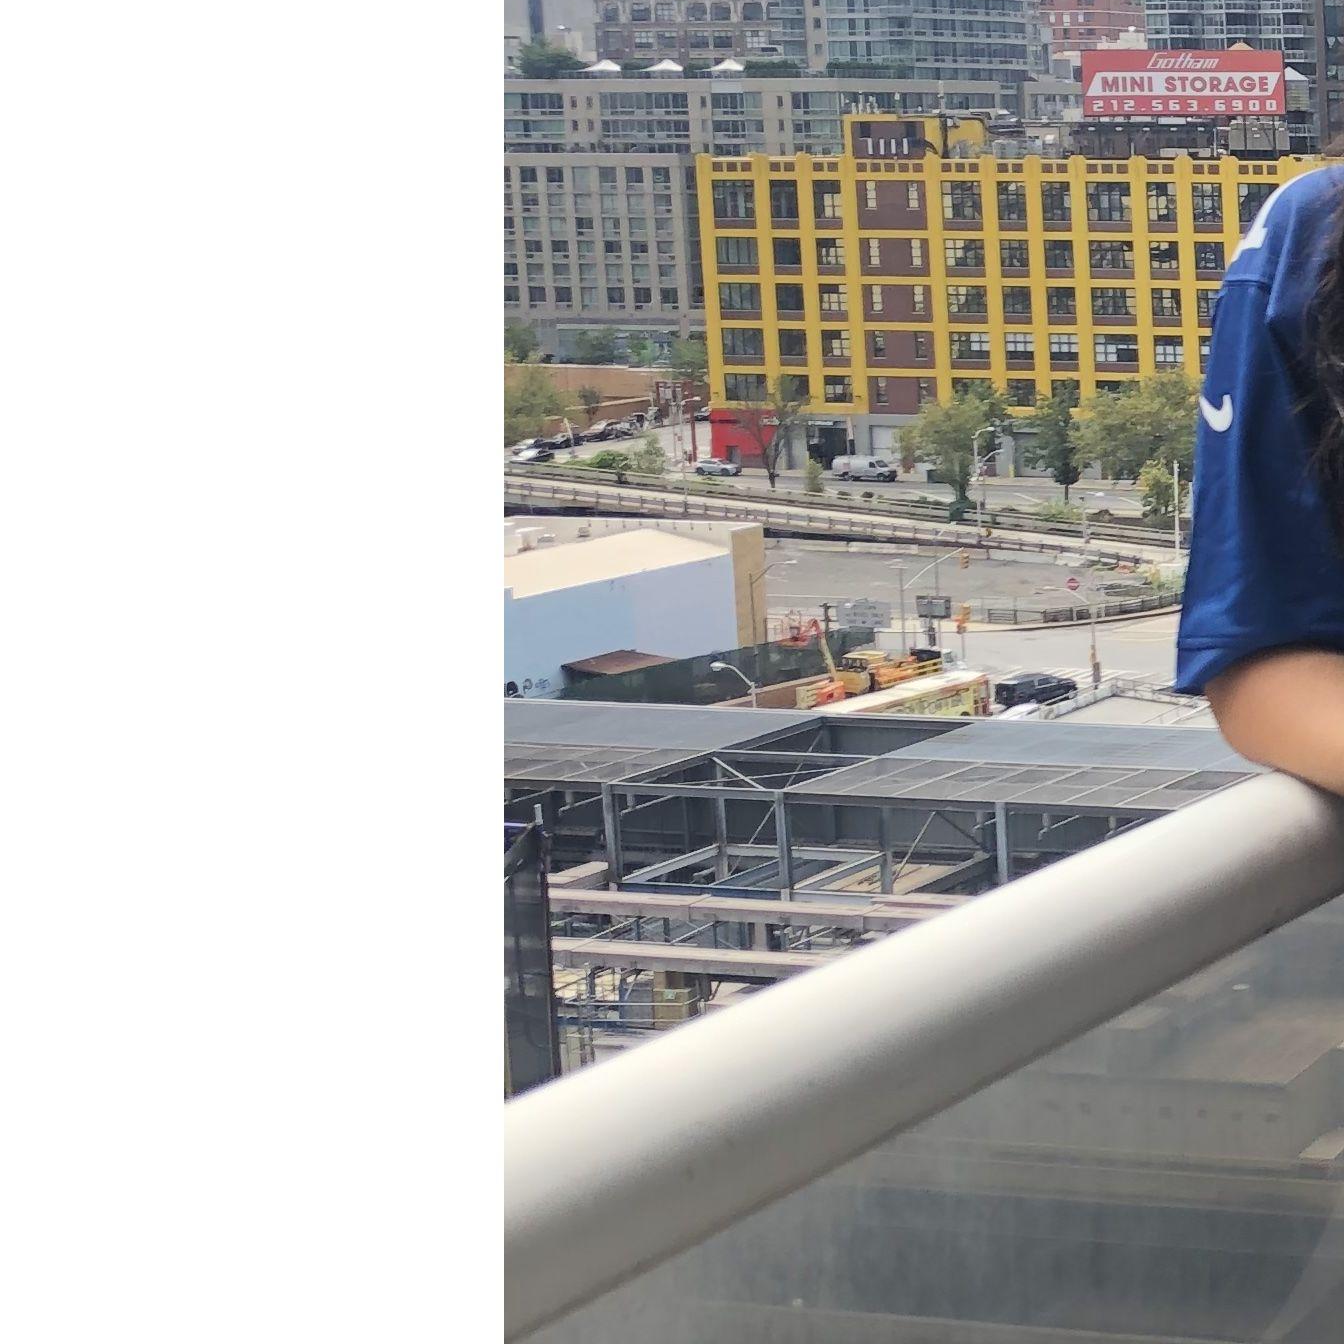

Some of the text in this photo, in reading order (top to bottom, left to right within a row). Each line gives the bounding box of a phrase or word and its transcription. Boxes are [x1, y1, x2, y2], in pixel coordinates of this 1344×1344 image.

[1146, 52, 1220, 69] Gotham
[1101, 75, 1270, 93] MINI STORAGE
[1092, 99, 1278, 112] 212.563.6900
